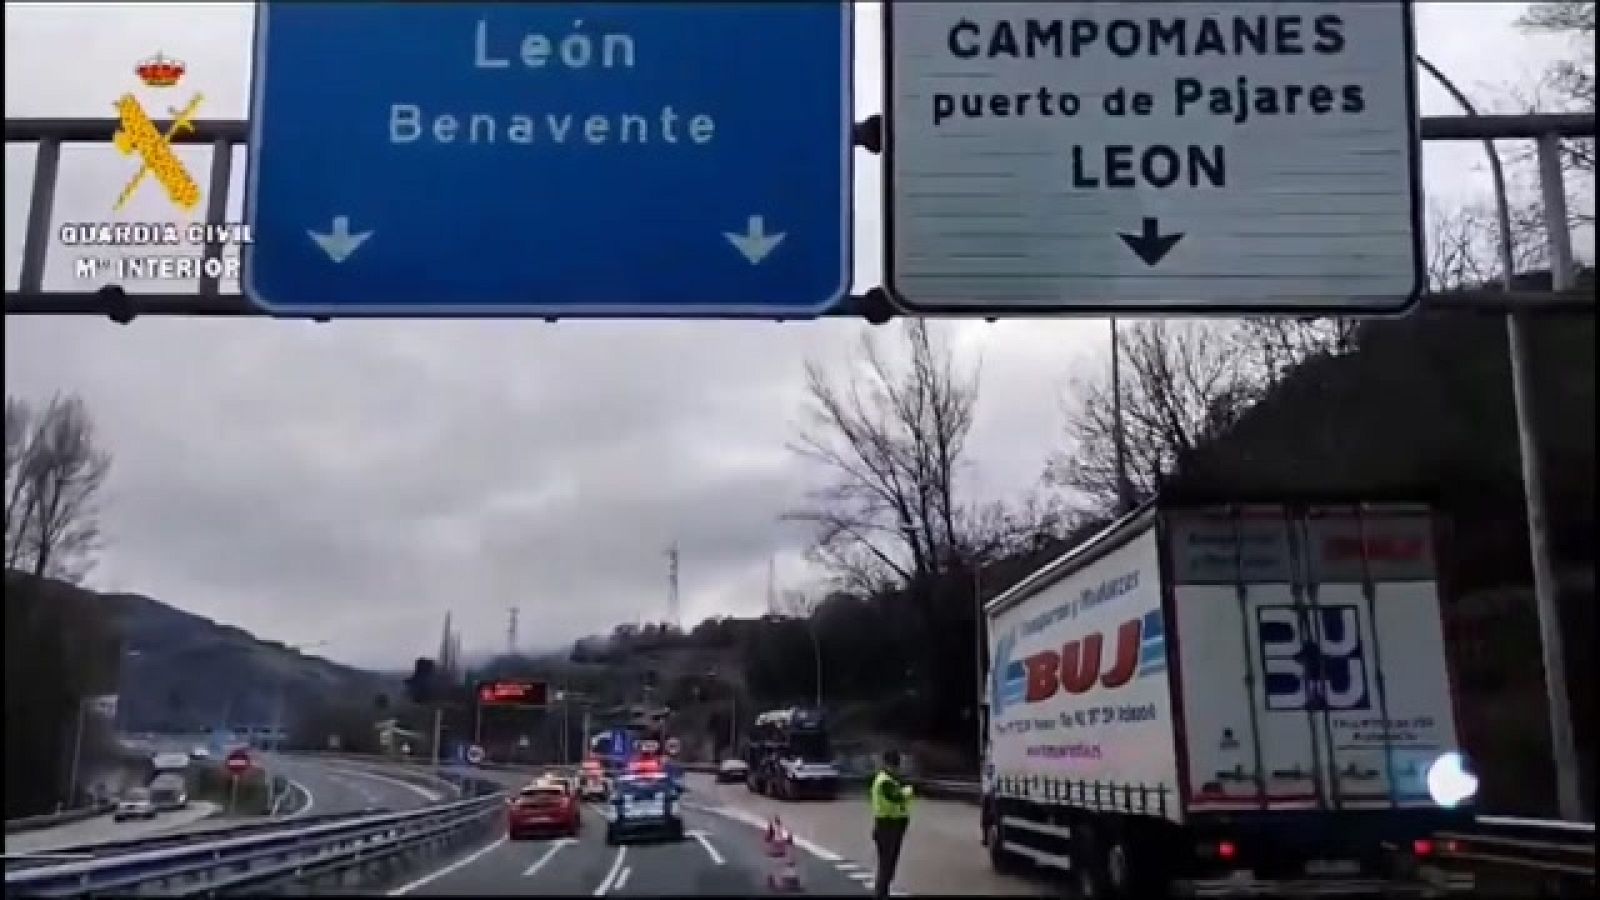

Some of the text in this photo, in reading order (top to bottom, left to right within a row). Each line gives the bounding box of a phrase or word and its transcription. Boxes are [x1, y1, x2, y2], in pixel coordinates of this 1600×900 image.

[474, 19, 635, 68] León
[947, 14, 1347, 59] CAMPOMANES
[389, 103, 715, 145] Benavente
[933, 76, 1366, 126] puerto de Pajares
[1072, 144, 1227, 190] LEON
[1025, 618, 1142, 703] BUJ
